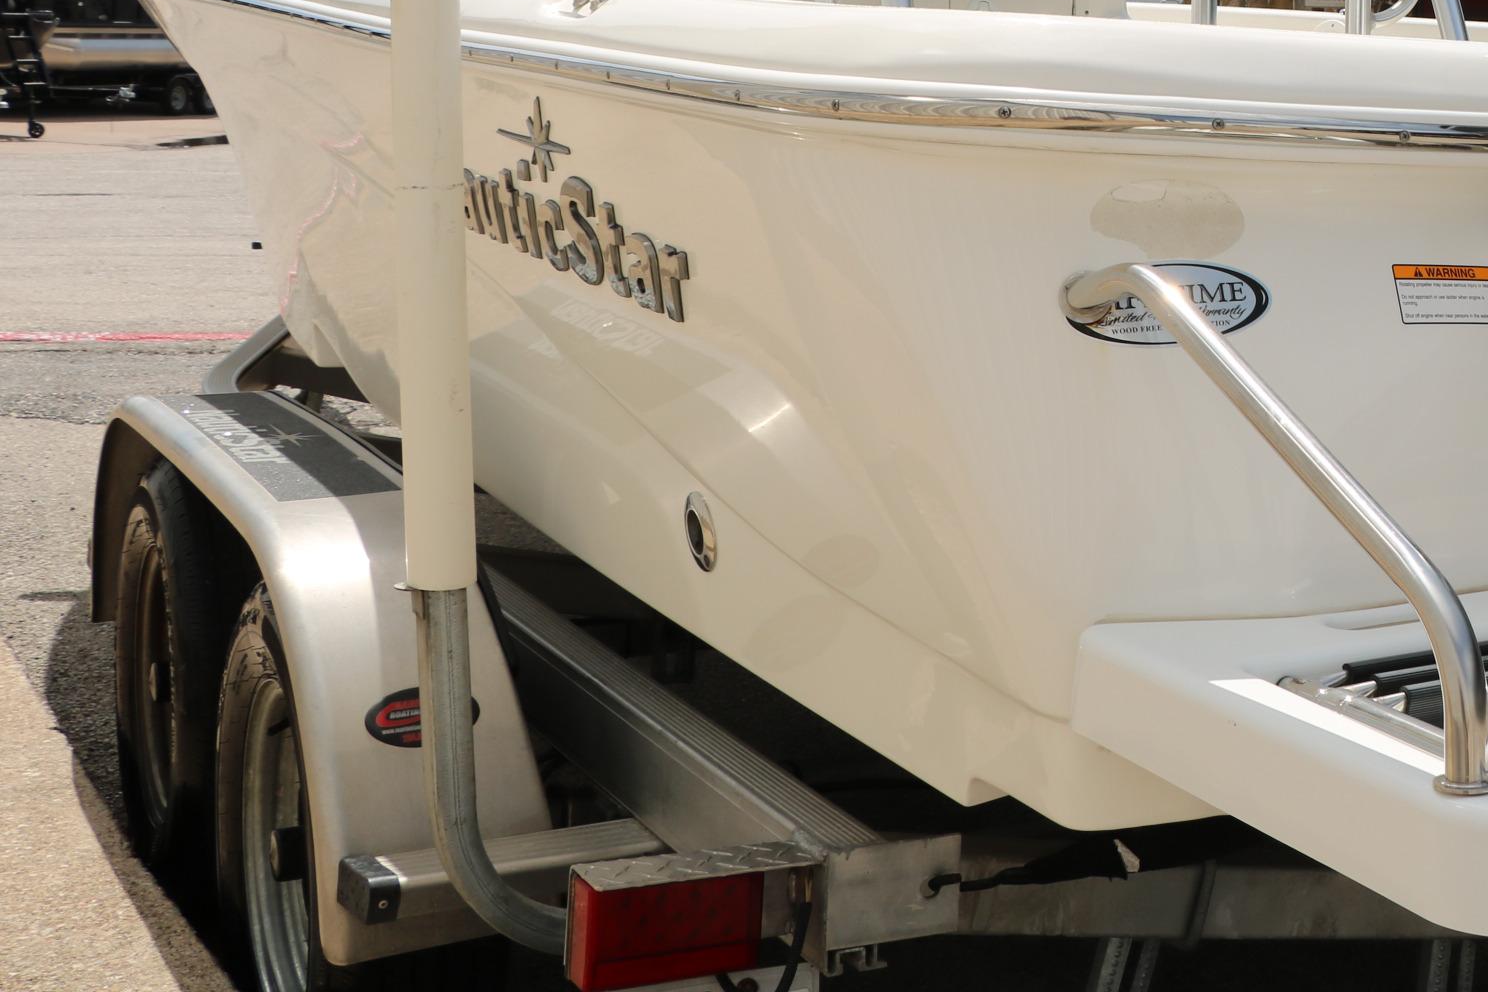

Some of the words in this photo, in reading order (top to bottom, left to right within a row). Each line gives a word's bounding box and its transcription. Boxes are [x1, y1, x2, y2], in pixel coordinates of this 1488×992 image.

[463, 159, 690, 324] auticStar
[1425, 267, 1476, 278] WARNING
[1111, 326, 1138, 334] WOOD
[1140, 324, 1163, 333] FREE
